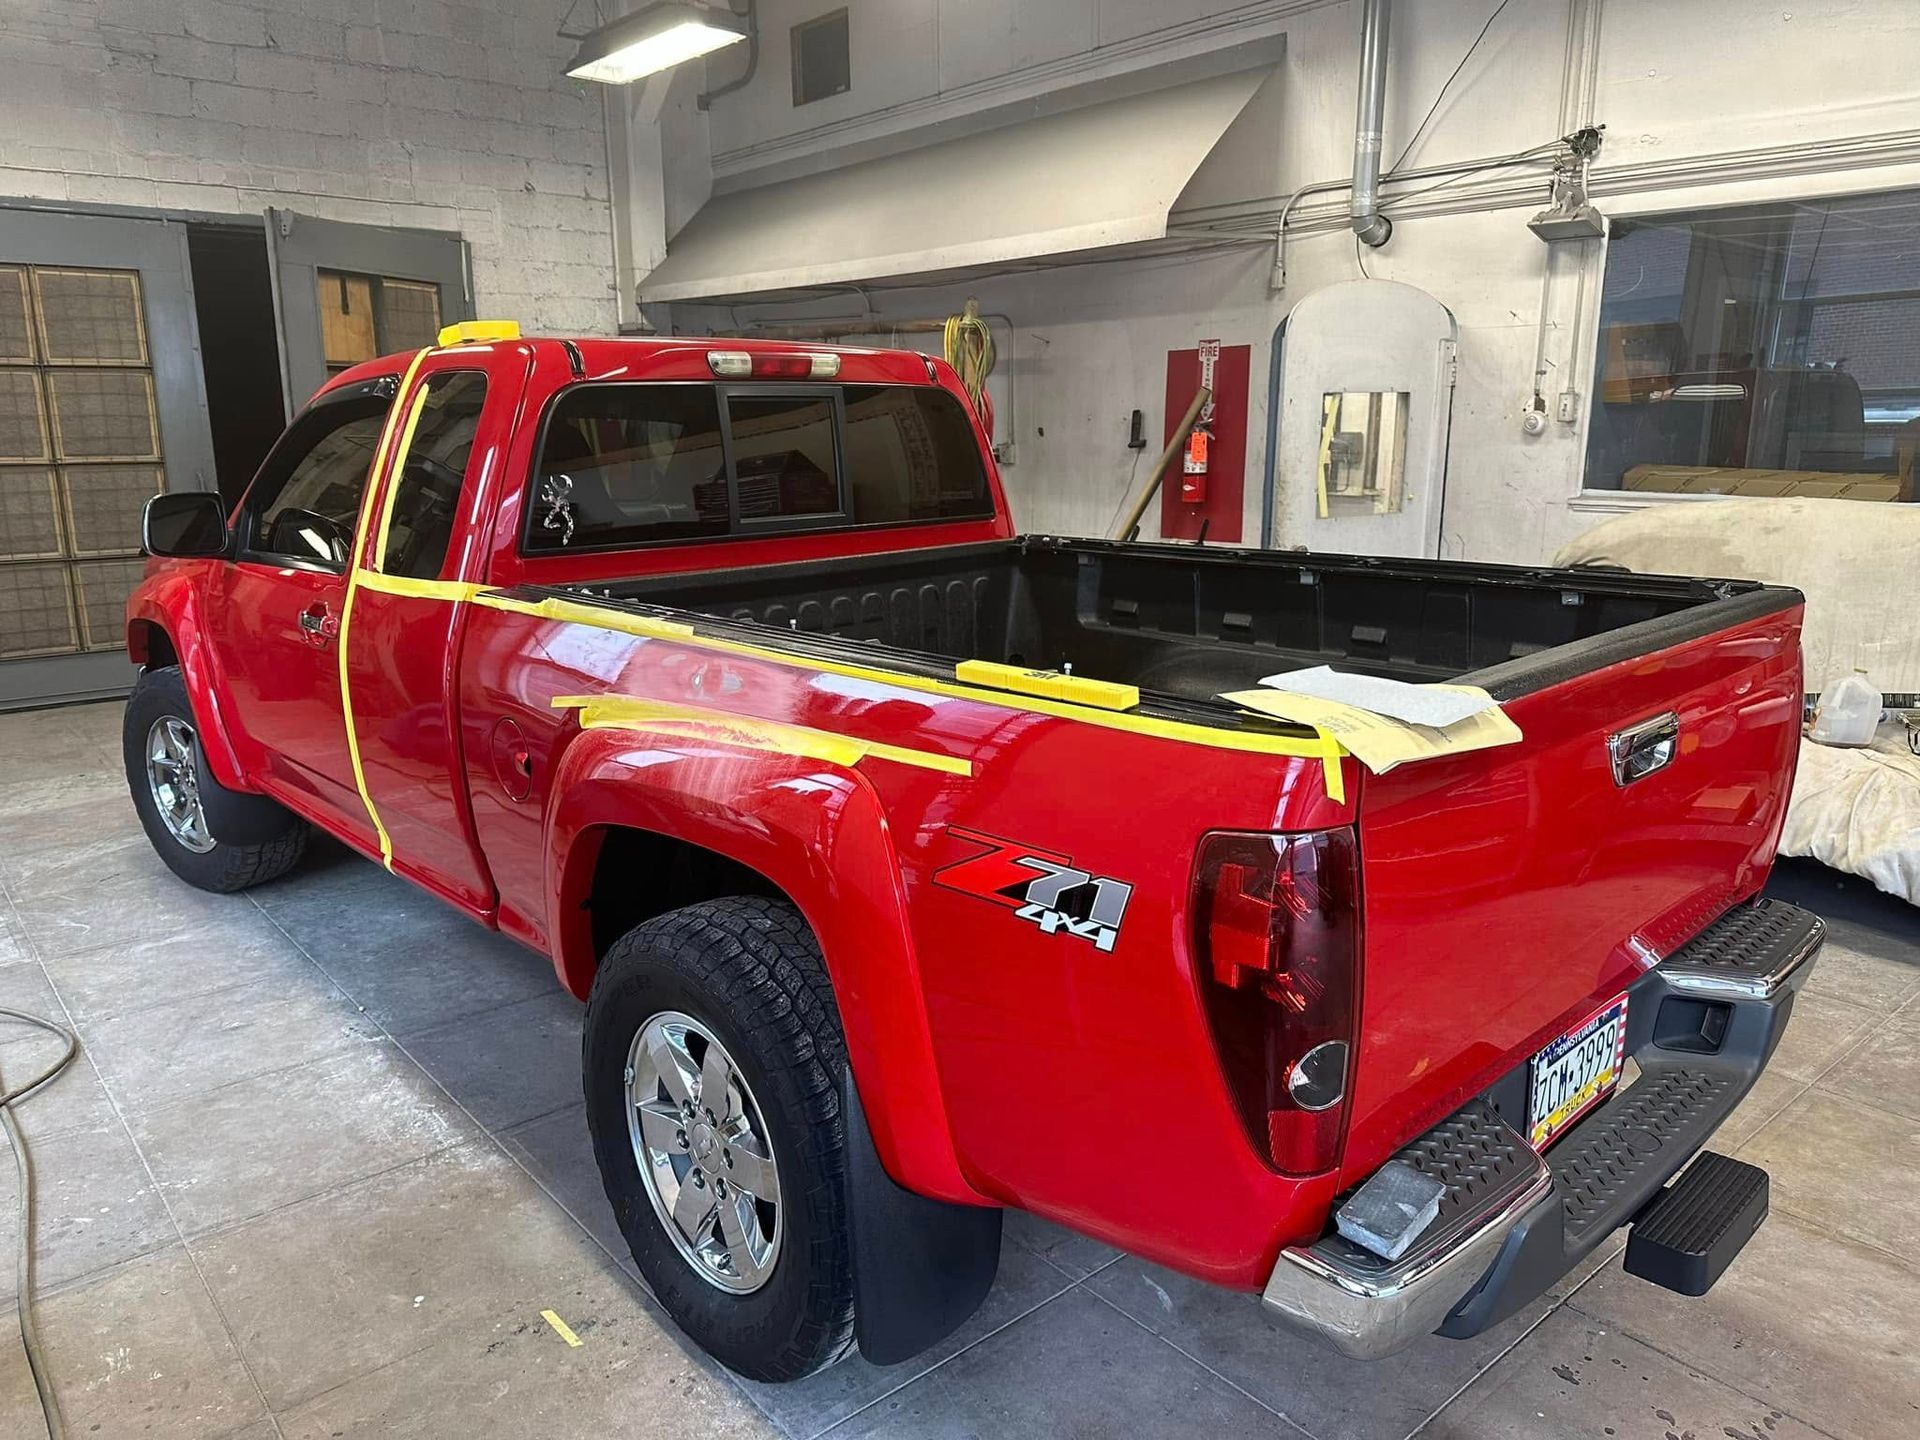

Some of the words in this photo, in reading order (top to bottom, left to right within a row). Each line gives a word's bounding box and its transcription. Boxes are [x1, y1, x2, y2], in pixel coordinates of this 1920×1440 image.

[1200, 346, 1218, 357] FIRE
[931, 824, 1135, 930] Z71
[1554, 1016, 1600, 1056] PENNSYLVANIA
[1559, 1092, 1587, 1119] TRUCK
